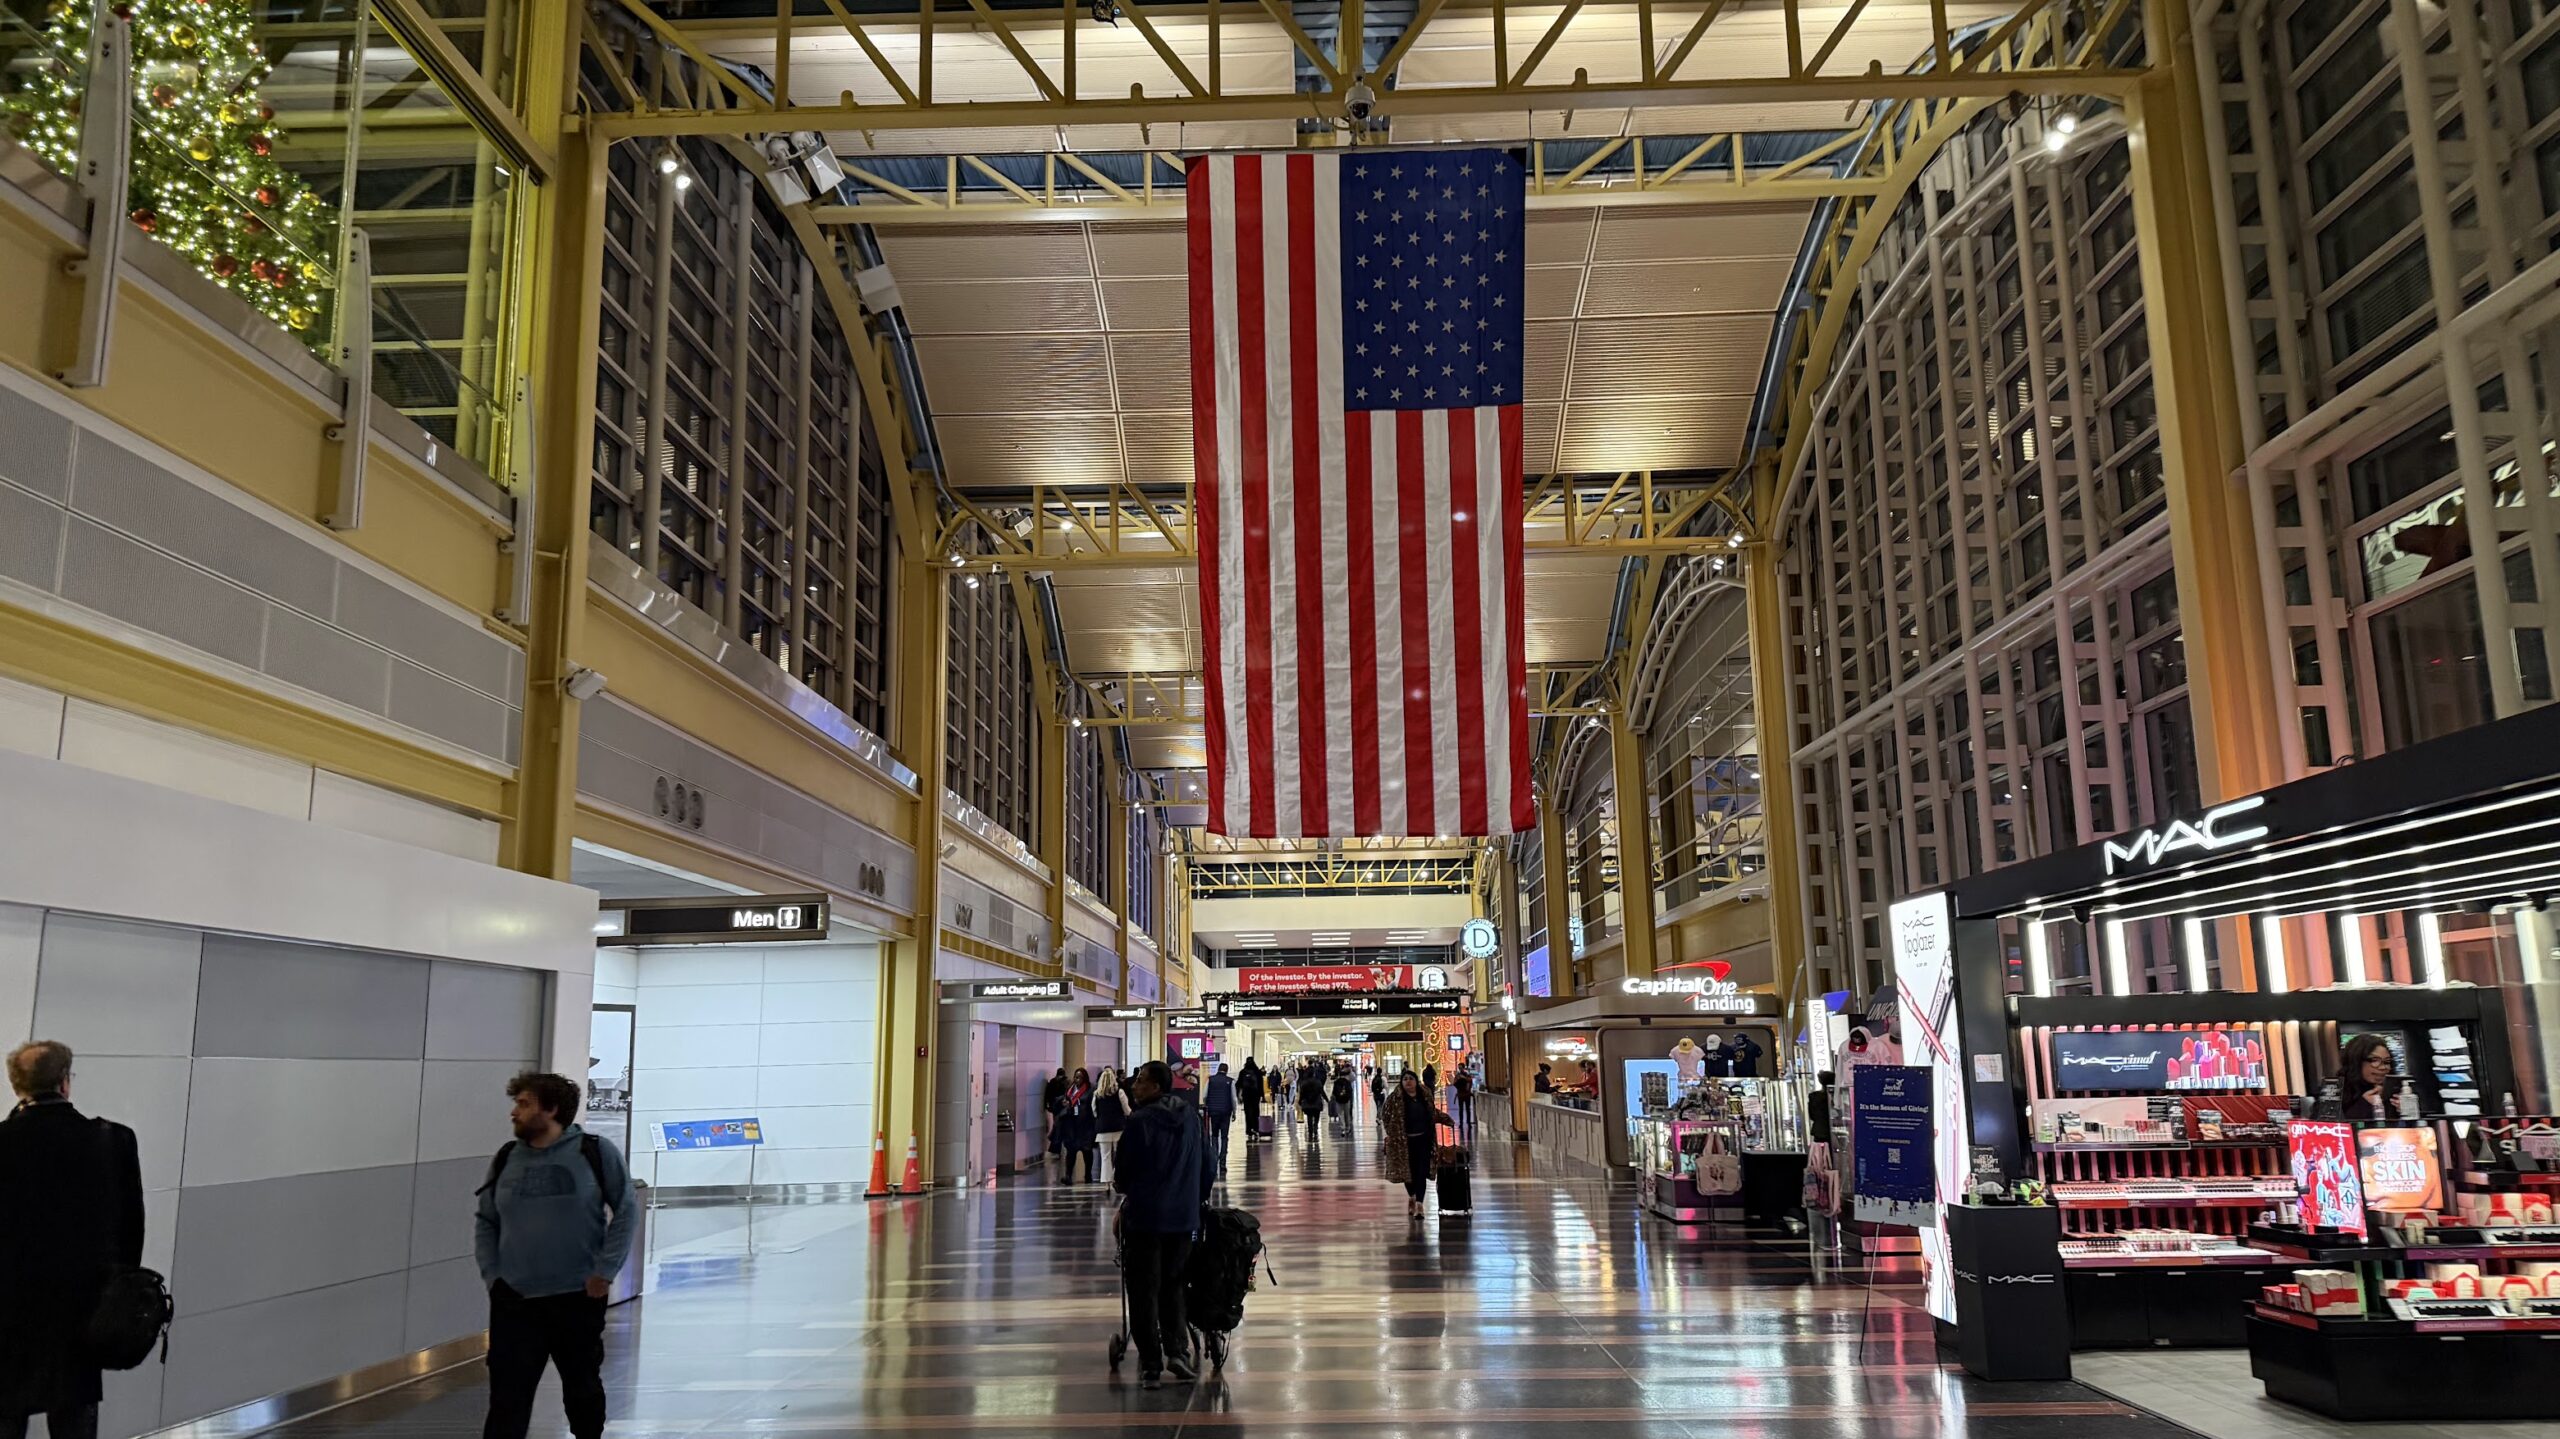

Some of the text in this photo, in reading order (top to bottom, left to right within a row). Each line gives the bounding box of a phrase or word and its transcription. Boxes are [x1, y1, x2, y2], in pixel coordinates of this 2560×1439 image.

[733, 910, 775, 928] Men
[1473, 928, 1490, 948] D
[1261, 973, 1274, 981] the
[1275, 972, 1306, 981] investor.
[1307, 972, 1317, 982] By
[1318, 972, 1332, 980] the
[1333, 971, 1364, 980] investor.
[983, 985, 1047, 996] Adult Changing
[1278, 982, 1309, 990] investor.
[1310, 982, 1330, 990] Since
[1693, 995, 1755, 1014] landing
[1880, 1104, 1901, 1112] Season
[1908, 1105, 1929, 1114] Giving!
[2372, 1159, 2427, 1181] SKIN
[1987, 1274, 2055, 1285] MAC
